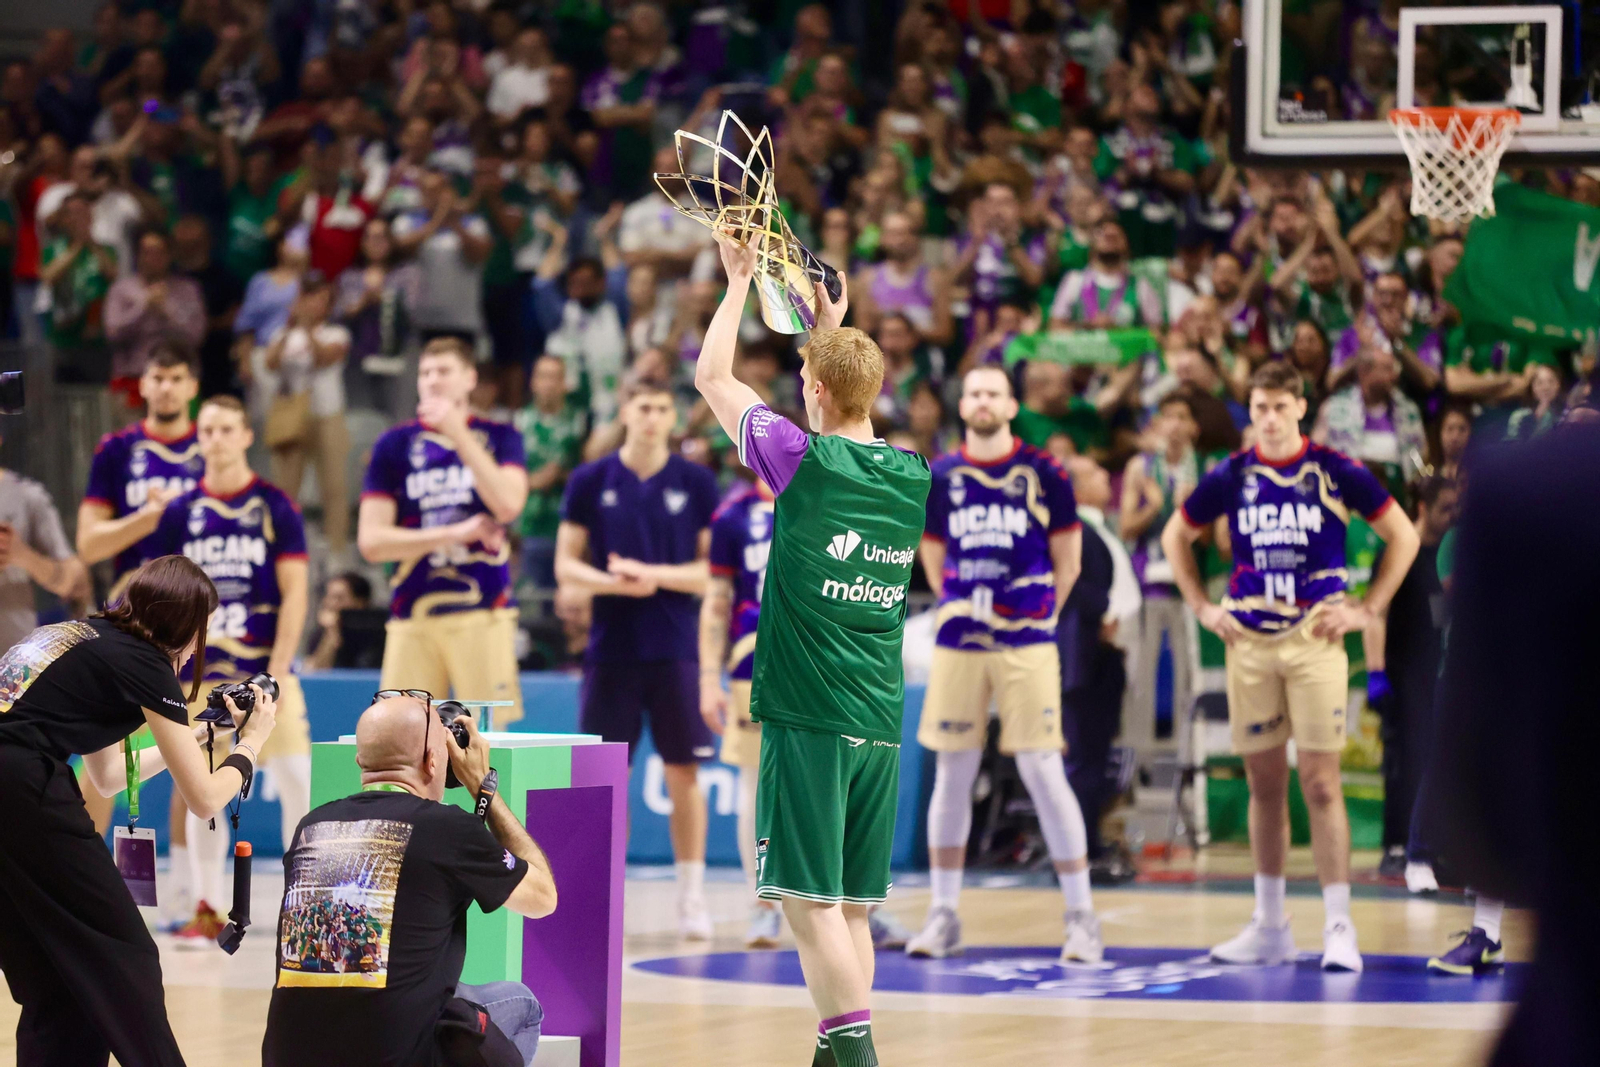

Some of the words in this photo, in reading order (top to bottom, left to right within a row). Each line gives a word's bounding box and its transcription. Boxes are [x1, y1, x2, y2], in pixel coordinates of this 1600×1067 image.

[948, 503, 1028, 538] UCAM
[1237, 502, 1321, 535] UCAM
[183, 534, 266, 567] UCAM
[1250, 530, 1309, 548] MURCIA
[863, 543, 914, 569] Unicaja
[822, 576, 904, 609] málaga
[1264, 571, 1296, 607] 14
[208, 602, 248, 639] 22
